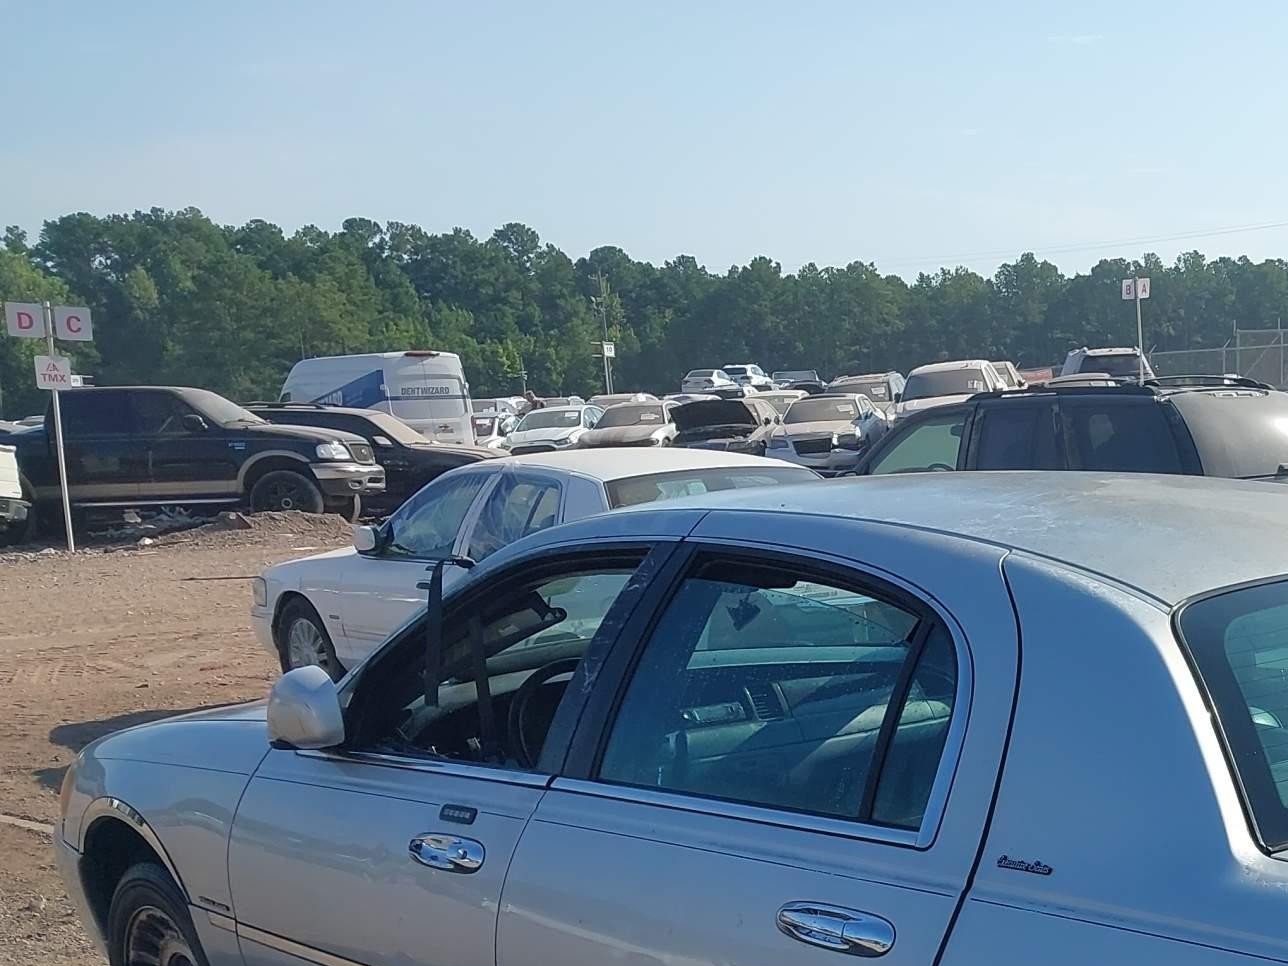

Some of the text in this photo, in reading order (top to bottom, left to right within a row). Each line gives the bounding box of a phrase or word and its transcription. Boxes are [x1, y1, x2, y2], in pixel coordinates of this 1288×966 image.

[1141, 283, 1147, 294] A
[17, 312, 34, 329] D
[66, 315, 81, 333] C
[40, 373, 66, 383] TMX
